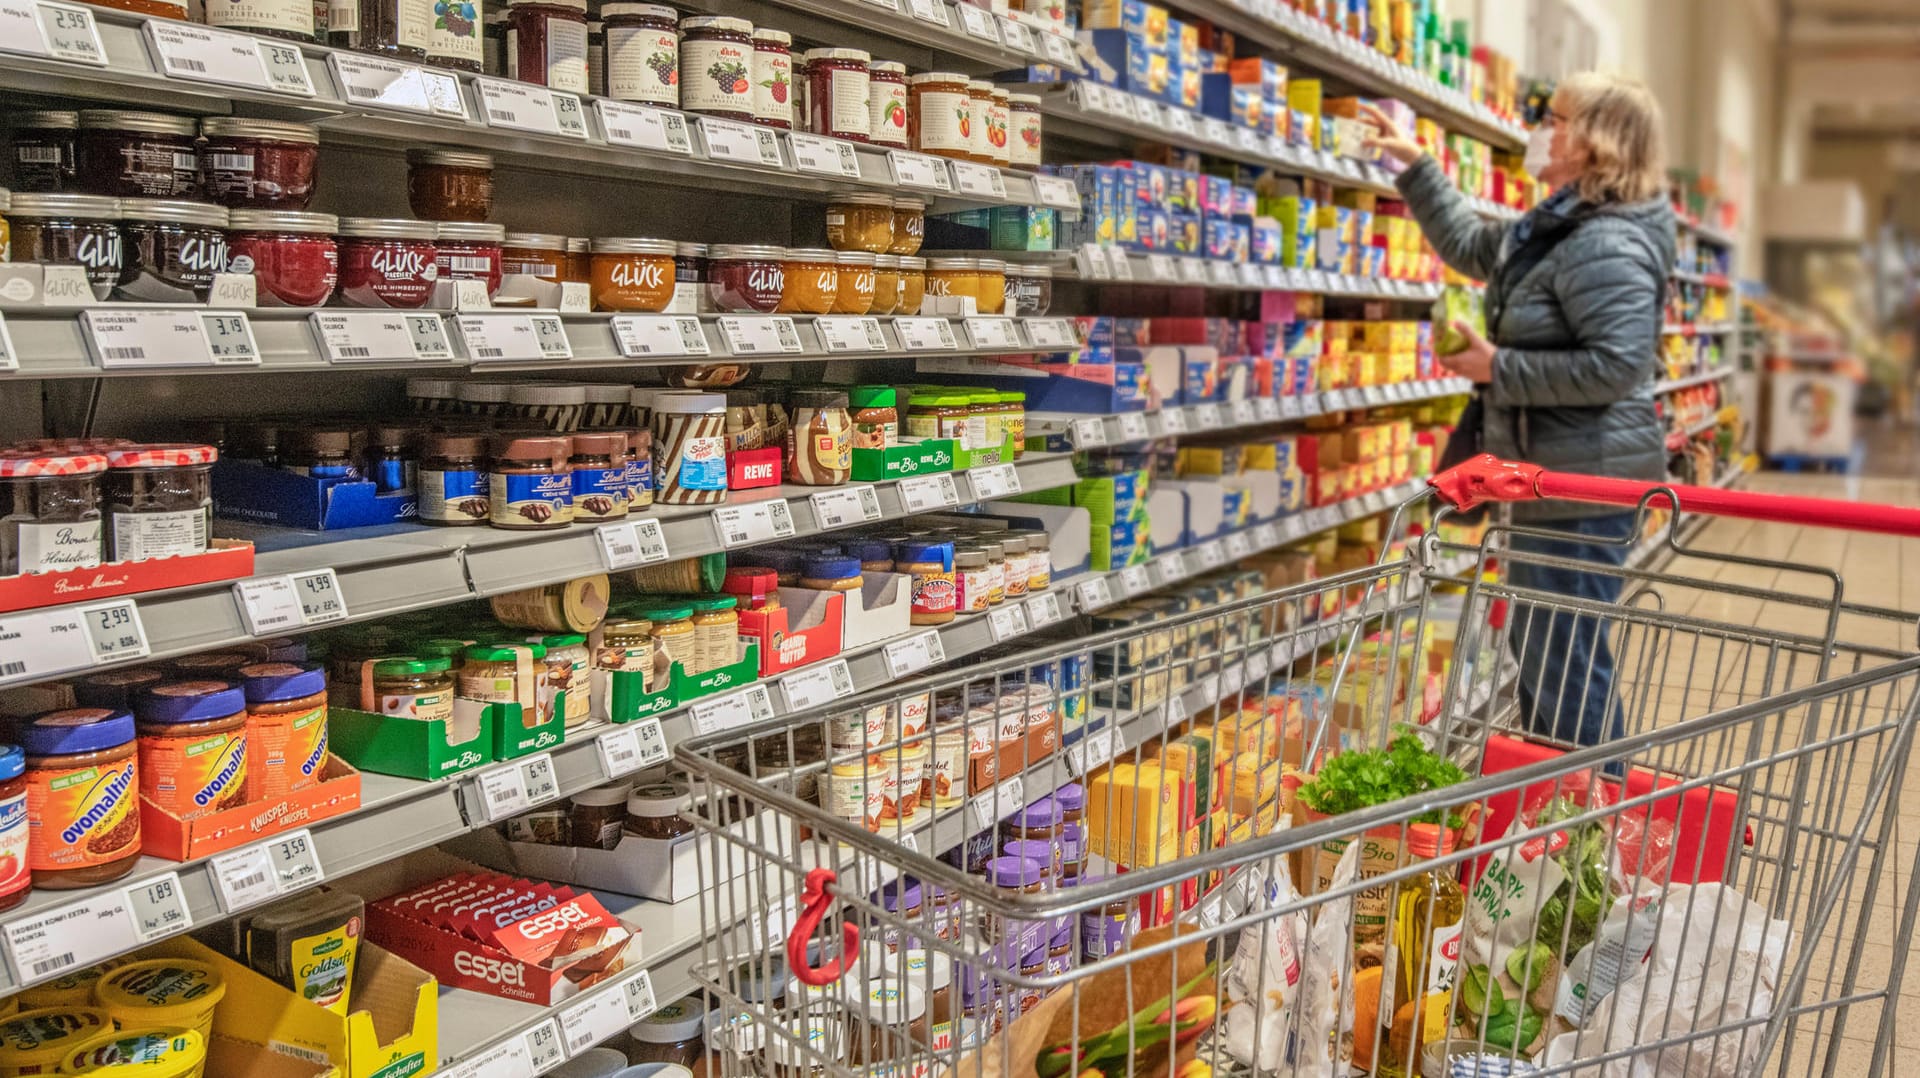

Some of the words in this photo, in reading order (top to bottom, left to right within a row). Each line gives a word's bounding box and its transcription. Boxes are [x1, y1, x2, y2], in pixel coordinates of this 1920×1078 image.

[56, 11, 86, 29] 2.99
[272, 48, 297, 66] 2.99
[371, 249, 425, 273] GLÜCK
[611, 262, 664, 288] GLÜCK
[215, 318, 243, 335] 3.19
[900, 456, 917, 473] Bio
[934, 450, 951, 465] Bio
[743, 463, 773, 481] REWE
[53, 578, 84, 595] Bonne
[306, 575, 331, 594] 4.99
[100, 608, 130, 630] 2.99
[713, 673, 732, 687] Bio
[652, 697, 672, 712] Bio
[535, 732, 557, 748] Bio
[459, 751, 482, 769] Bio
[529, 761, 547, 780] 6.49
[62, 763, 135, 845] ovomaltine
[250, 801, 288, 833] KNUSPER
[279, 808, 312, 827] KNUSPER
[282, 838, 306, 860] 3.59
[1362, 842, 1395, 861] Bio
[148, 882, 173, 905] 1.89
[68, 906, 90, 919] EXTRA
[14, 930, 46, 946] MAINTAL
[300, 949, 351, 979] Goldsaft
[501, 984, 535, 1000] Schnitten
